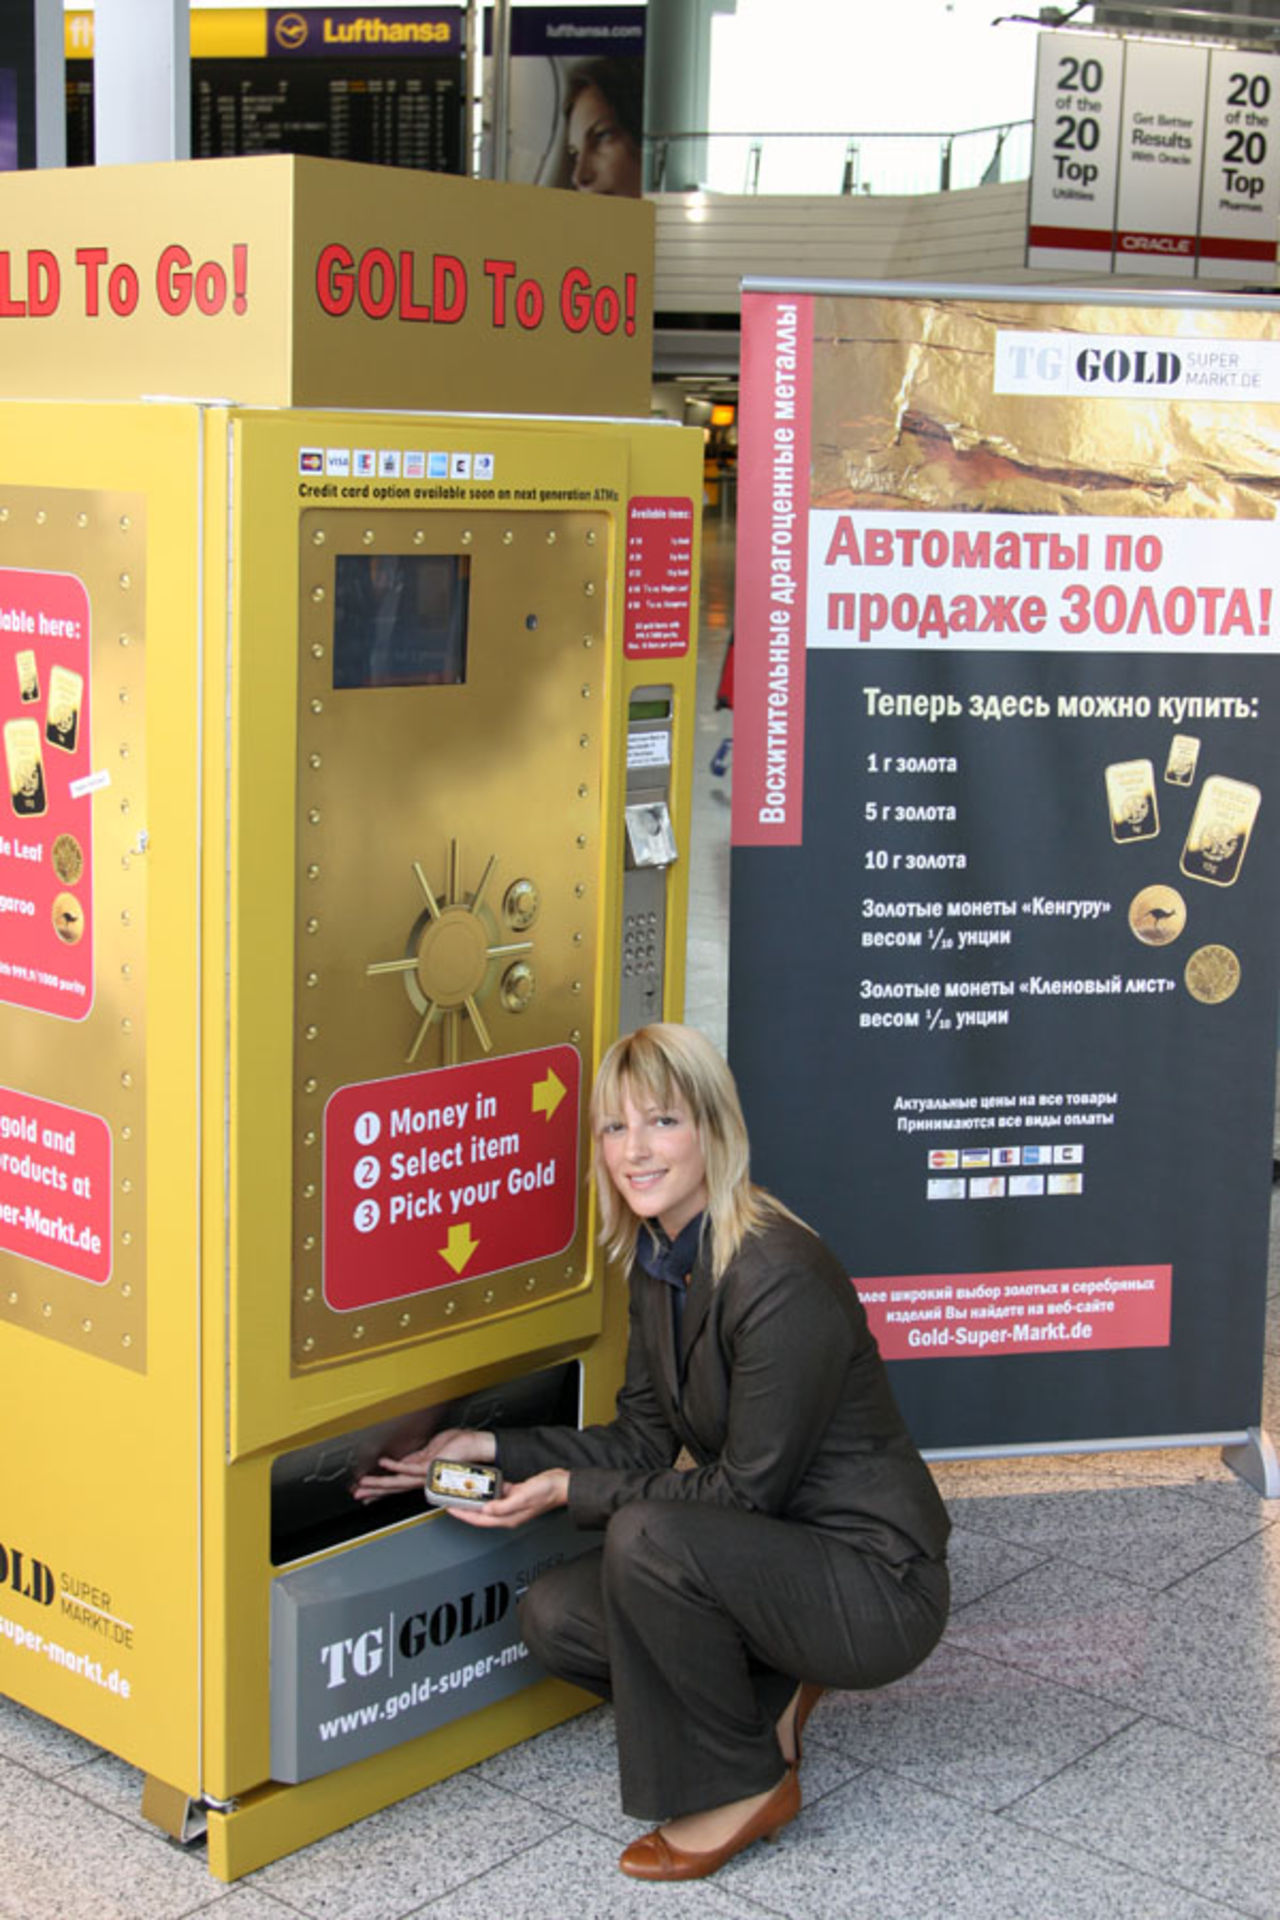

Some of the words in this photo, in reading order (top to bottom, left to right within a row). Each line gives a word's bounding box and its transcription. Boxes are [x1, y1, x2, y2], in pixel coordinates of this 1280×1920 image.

[324, 19, 450, 43] Lufthansa
[546, 23, 642, 37] lufthansa.com
[1057, 56, 1104, 93] 20
[1055, 95, 1070, 110] of
[1077, 97, 1102, 113] the
[1226, 72, 1271, 108] 20
[1133, 112, 1154, 126] Get
[1158, 115, 1193, 129] Better
[1225, 110, 1241, 125] of
[1246, 112, 1269, 127] the
[1053, 115, 1100, 151] 20
[1131, 129, 1192, 149] Results
[1158, 153, 1191, 165] Oracle
[1223, 130, 1267, 165] 20
[1053, 155, 1099, 187] Top
[1222, 168, 1264, 199] Top
[1122, 235, 1191, 253] ORACLE
[76, 247, 139, 317] To
[156, 244, 248, 317] Go!
[316, 244, 467, 325] GOLD
[484, 259, 544, 330] To
[560, 267, 637, 338] Go!
[774, 305, 797, 419] металлы
[1009, 346, 1062, 381] TG
[1076, 348, 1182, 384] GOLD
[1186, 353, 1239, 368] SUPER
[1186, 372, 1261, 389] MARKT.DE
[298, 483, 339, 499] Credit
[341, 484, 369, 499] card
[372, 485, 411, 501] option
[413, 485, 467, 500] available
[470, 488, 495, 500] soon
[498, 489, 511, 500] on
[514, 487, 537, 500] next
[539, 488, 591, 502] generation
[770, 428, 797, 604] драгоценные
[824, 515, 1089, 571] Автоматы
[1105, 534, 1163, 572] по
[38, 611, 81, 640] here:
[827, 591, 1048, 642] продаже
[1059, 584, 1273, 637] ЗОЛОТА!
[759, 610, 790, 824] Восхитительные
[863, 687, 962, 722] Теперь
[969, 692, 1049, 721] здесь
[1056, 693, 1151, 719] можно
[1157, 695, 1259, 724] купить:
[867, 754, 877, 773] 1
[883, 757, 893, 773] г
[896, 757, 957, 774] золота
[865, 802, 877, 821] 5
[882, 806, 892, 821] г
[895, 805, 956, 822] золота
[13, 838, 43, 863] Leaf
[864, 850, 888, 870] 10
[892, 854, 902, 869] г
[904, 853, 967, 870] золота
[861, 897, 943, 919] Золотые
[947, 900, 1017, 917] монеты
[1021, 896, 1111, 920] «Кенгуру»
[861, 930, 921, 947] весом
[957, 929, 1011, 950] унции
[860, 979, 941, 1000] Золотые
[944, 981, 1015, 997] монеты
[1019, 973, 1122, 996] «Кленовый
[1125, 977, 1175, 994] лист»
[859, 1011, 919, 1028] весом
[956, 1008, 1009, 1028] унции
[390, 1102, 468, 1138] Money
[476, 1092, 497, 1120] in
[893, 1096, 978, 1112] Актуальные
[980, 1095, 1016, 1109] цены
[1019, 1095, 1036, 1107] на
[1039, 1094, 1063, 1106] все
[1066, 1092, 1117, 1108] товары
[1, 1115, 37, 1144] gold
[42, 1129, 75, 1155] and
[897, 1117, 995, 1133] Принимаются
[999, 1116, 1022, 1128] все
[1025, 1114, 1061, 1128] виды
[1064, 1112, 1115, 1126] оплаты
[390, 1142, 463, 1181] Select
[471, 1133, 519, 1163] item
[72, 1176, 91, 1200] at
[390, 1188, 442, 1224] Pick
[450, 1179, 501, 1215] your
[508, 1159, 556, 1196] Gold
[891, 1285, 952, 1304] широкий
[956, 1284, 1000, 1301] выбор
[1004, 1282, 1058, 1298] золотых
[1073, 1276, 1155, 1295] серебряных
[886, 1305, 942, 1323] изделий
[945, 1304, 967, 1320] Вы
[970, 1302, 1024, 1319] найдете
[1028, 1302, 1044, 1316] на
[1047, 1298, 1115, 1315] веб-сайте
[908, 1321, 1092, 1347] Gold-Super-Markt.de
[60, 1571, 112, 1612] SUPER
[61, 1597, 134, 1650] MARKT.DE
[321, 1627, 383, 1689] TG
[399, 1580, 510, 1659] GOLD
